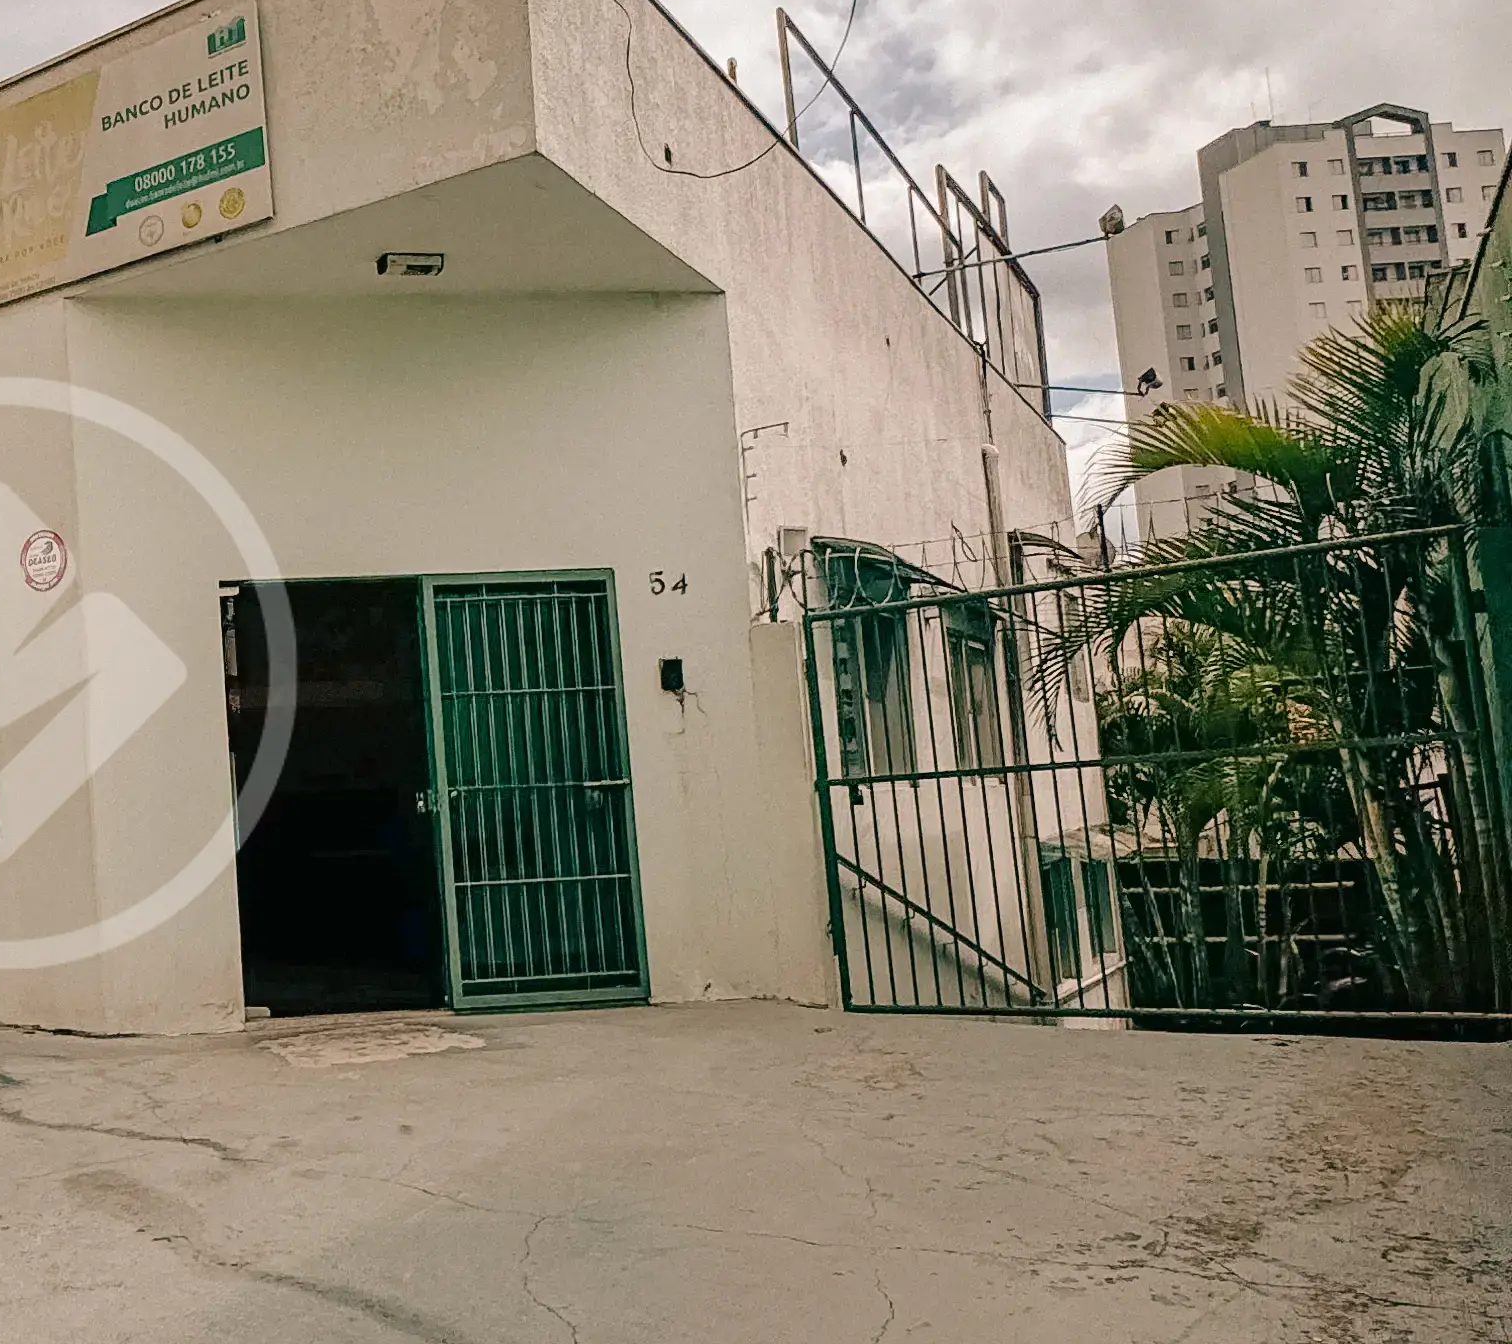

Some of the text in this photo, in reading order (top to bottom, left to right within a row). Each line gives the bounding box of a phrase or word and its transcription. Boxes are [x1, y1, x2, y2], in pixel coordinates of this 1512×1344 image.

[101, 59, 249, 132] BANCO DE LEITE
[164, 83, 250, 129] HUMANO
[134, 165, 176, 192] 08000
[180, 152, 205, 176] 178
[210, 142, 236, 164] 155
[649, 570, 688, 596] 54
